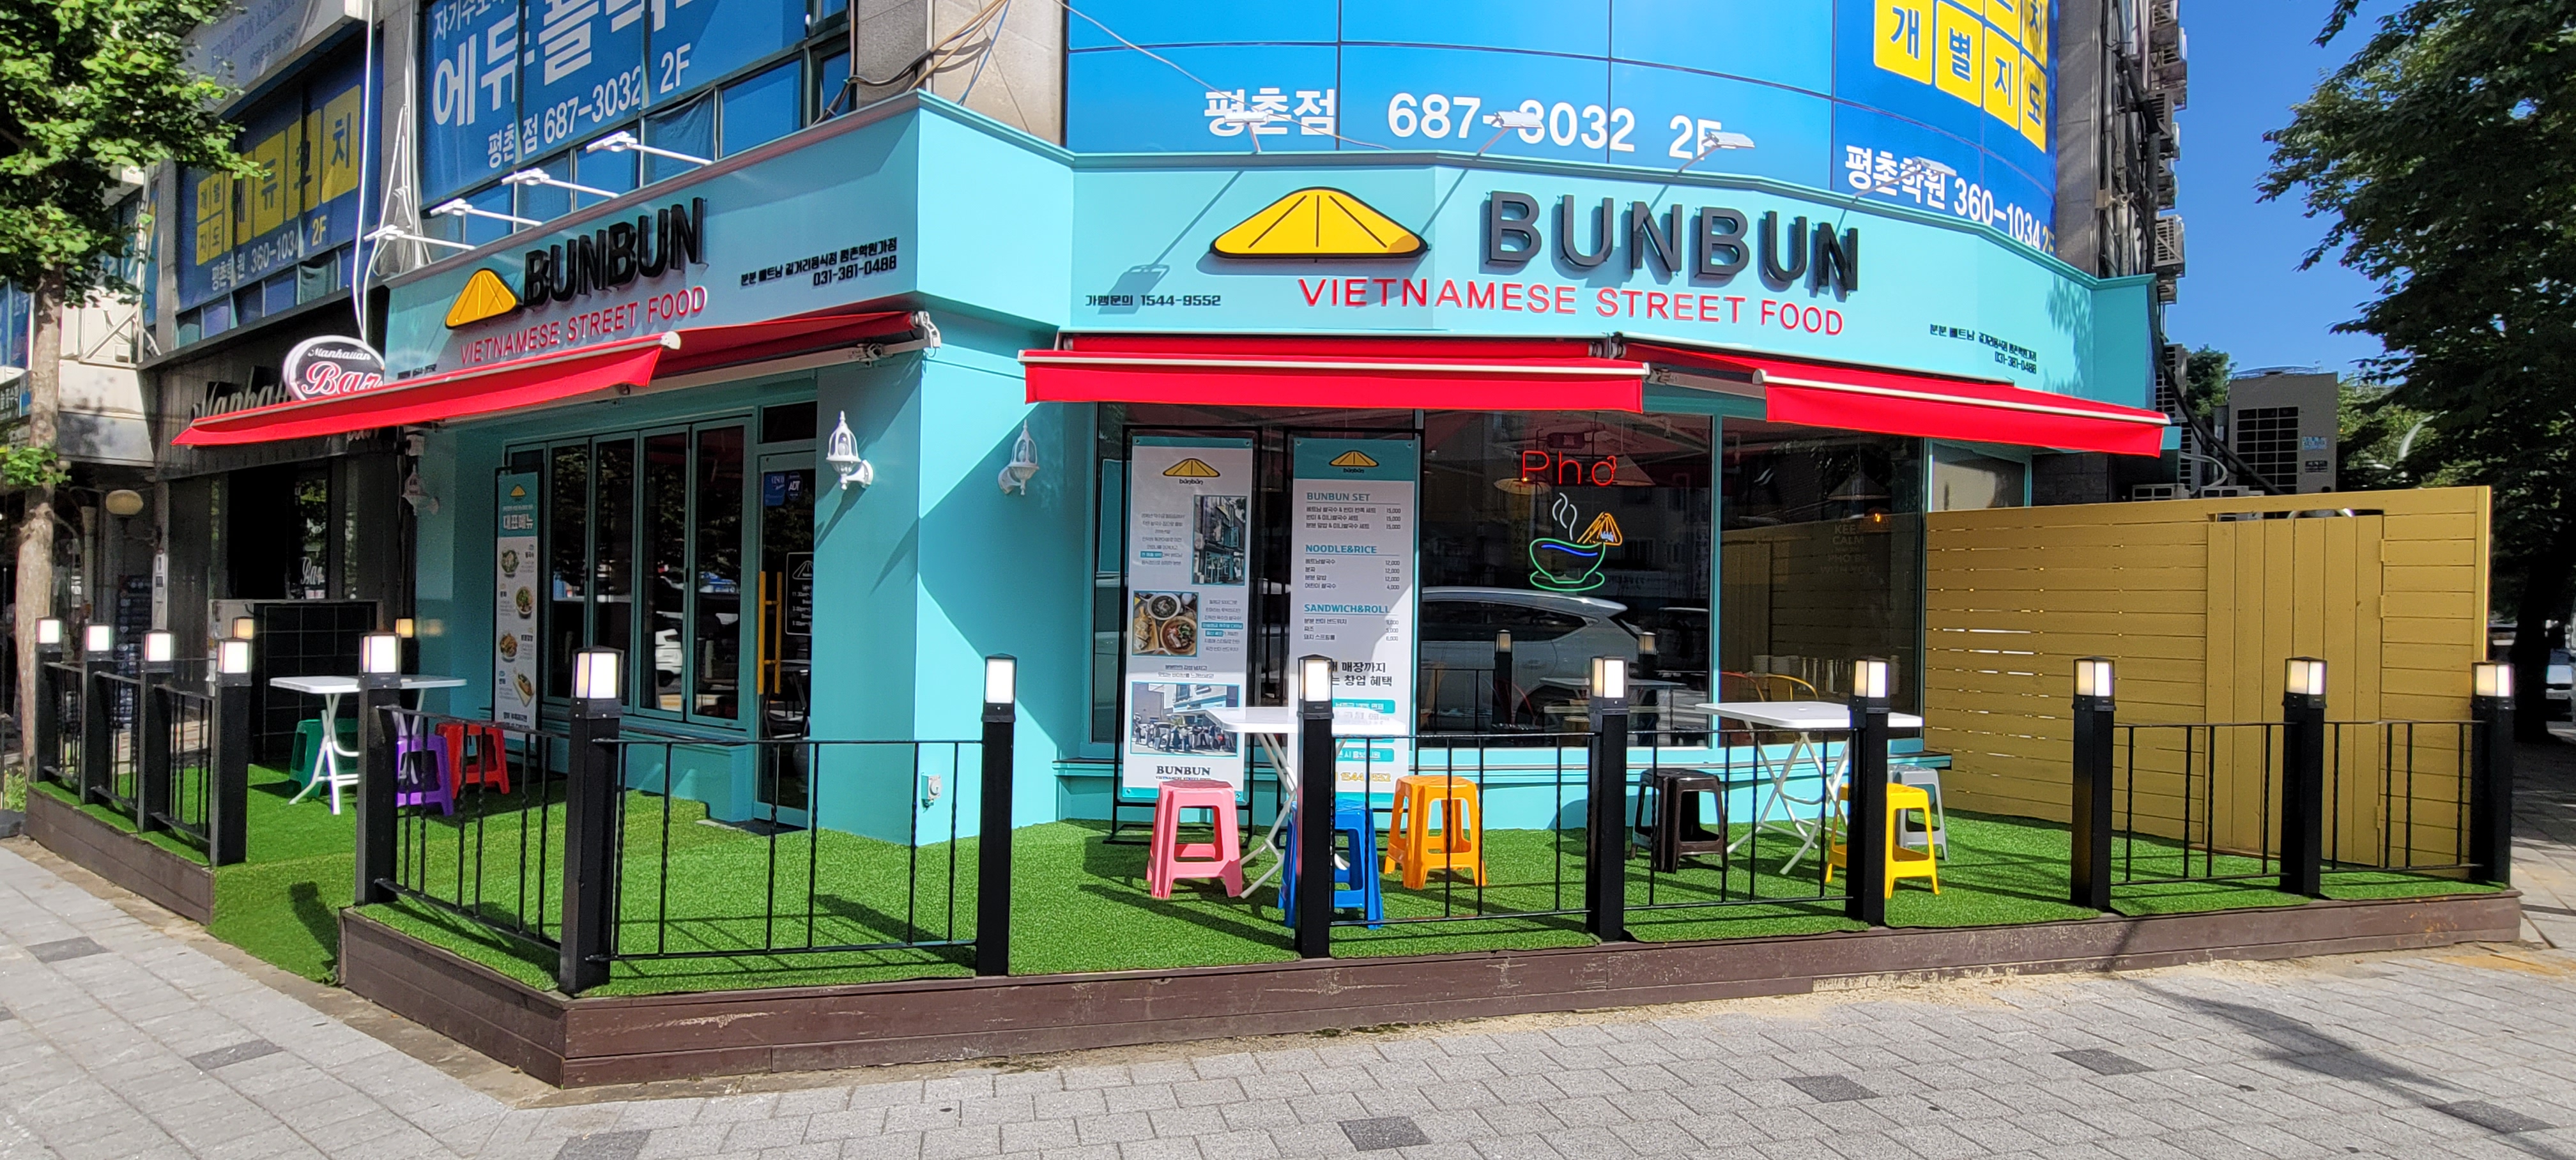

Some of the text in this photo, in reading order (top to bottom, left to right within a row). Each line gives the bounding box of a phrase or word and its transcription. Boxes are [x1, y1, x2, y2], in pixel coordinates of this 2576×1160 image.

[544, 65, 641, 144] 687-3032
[660, 43, 691, 94] 2F
[1204, 88, 1722, 161] 평촌점 687-3032 2F
[1844, 144, 1945, 210] 평촌학원
[1953, 177, 2041, 250] 360-1034
[312, 215, 326, 247] 2F
[1484, 190, 1859, 297] BUNBUN
[524, 196, 704, 307] BUNBUN
[740, 271, 757, 286] 분분
[813, 256, 897, 287] 031-381-0488
[1085, 294, 1222, 306] 가맹문의 1544-9552
[1298, 278, 1844, 336] VIETNAMESE STREET FOOD
[460, 286, 707, 365] VIETNAMESE STREET FOOD
[301, 362, 384, 397] Bar
[788, 480, 801, 491] ADT
[1307, 492, 1370, 501] BUNBUN SET
[1305, 544, 1377, 554] NOODLE&RICE
[1304, 604, 1391, 613] SANDWICH&ROLL
[1341, 661, 1386, 673] 매장까지
[1344, 675, 1366, 687] 창업
[1370, 676, 1393, 687] 혜택
[1156, 765, 1211, 775] BUNBUN
